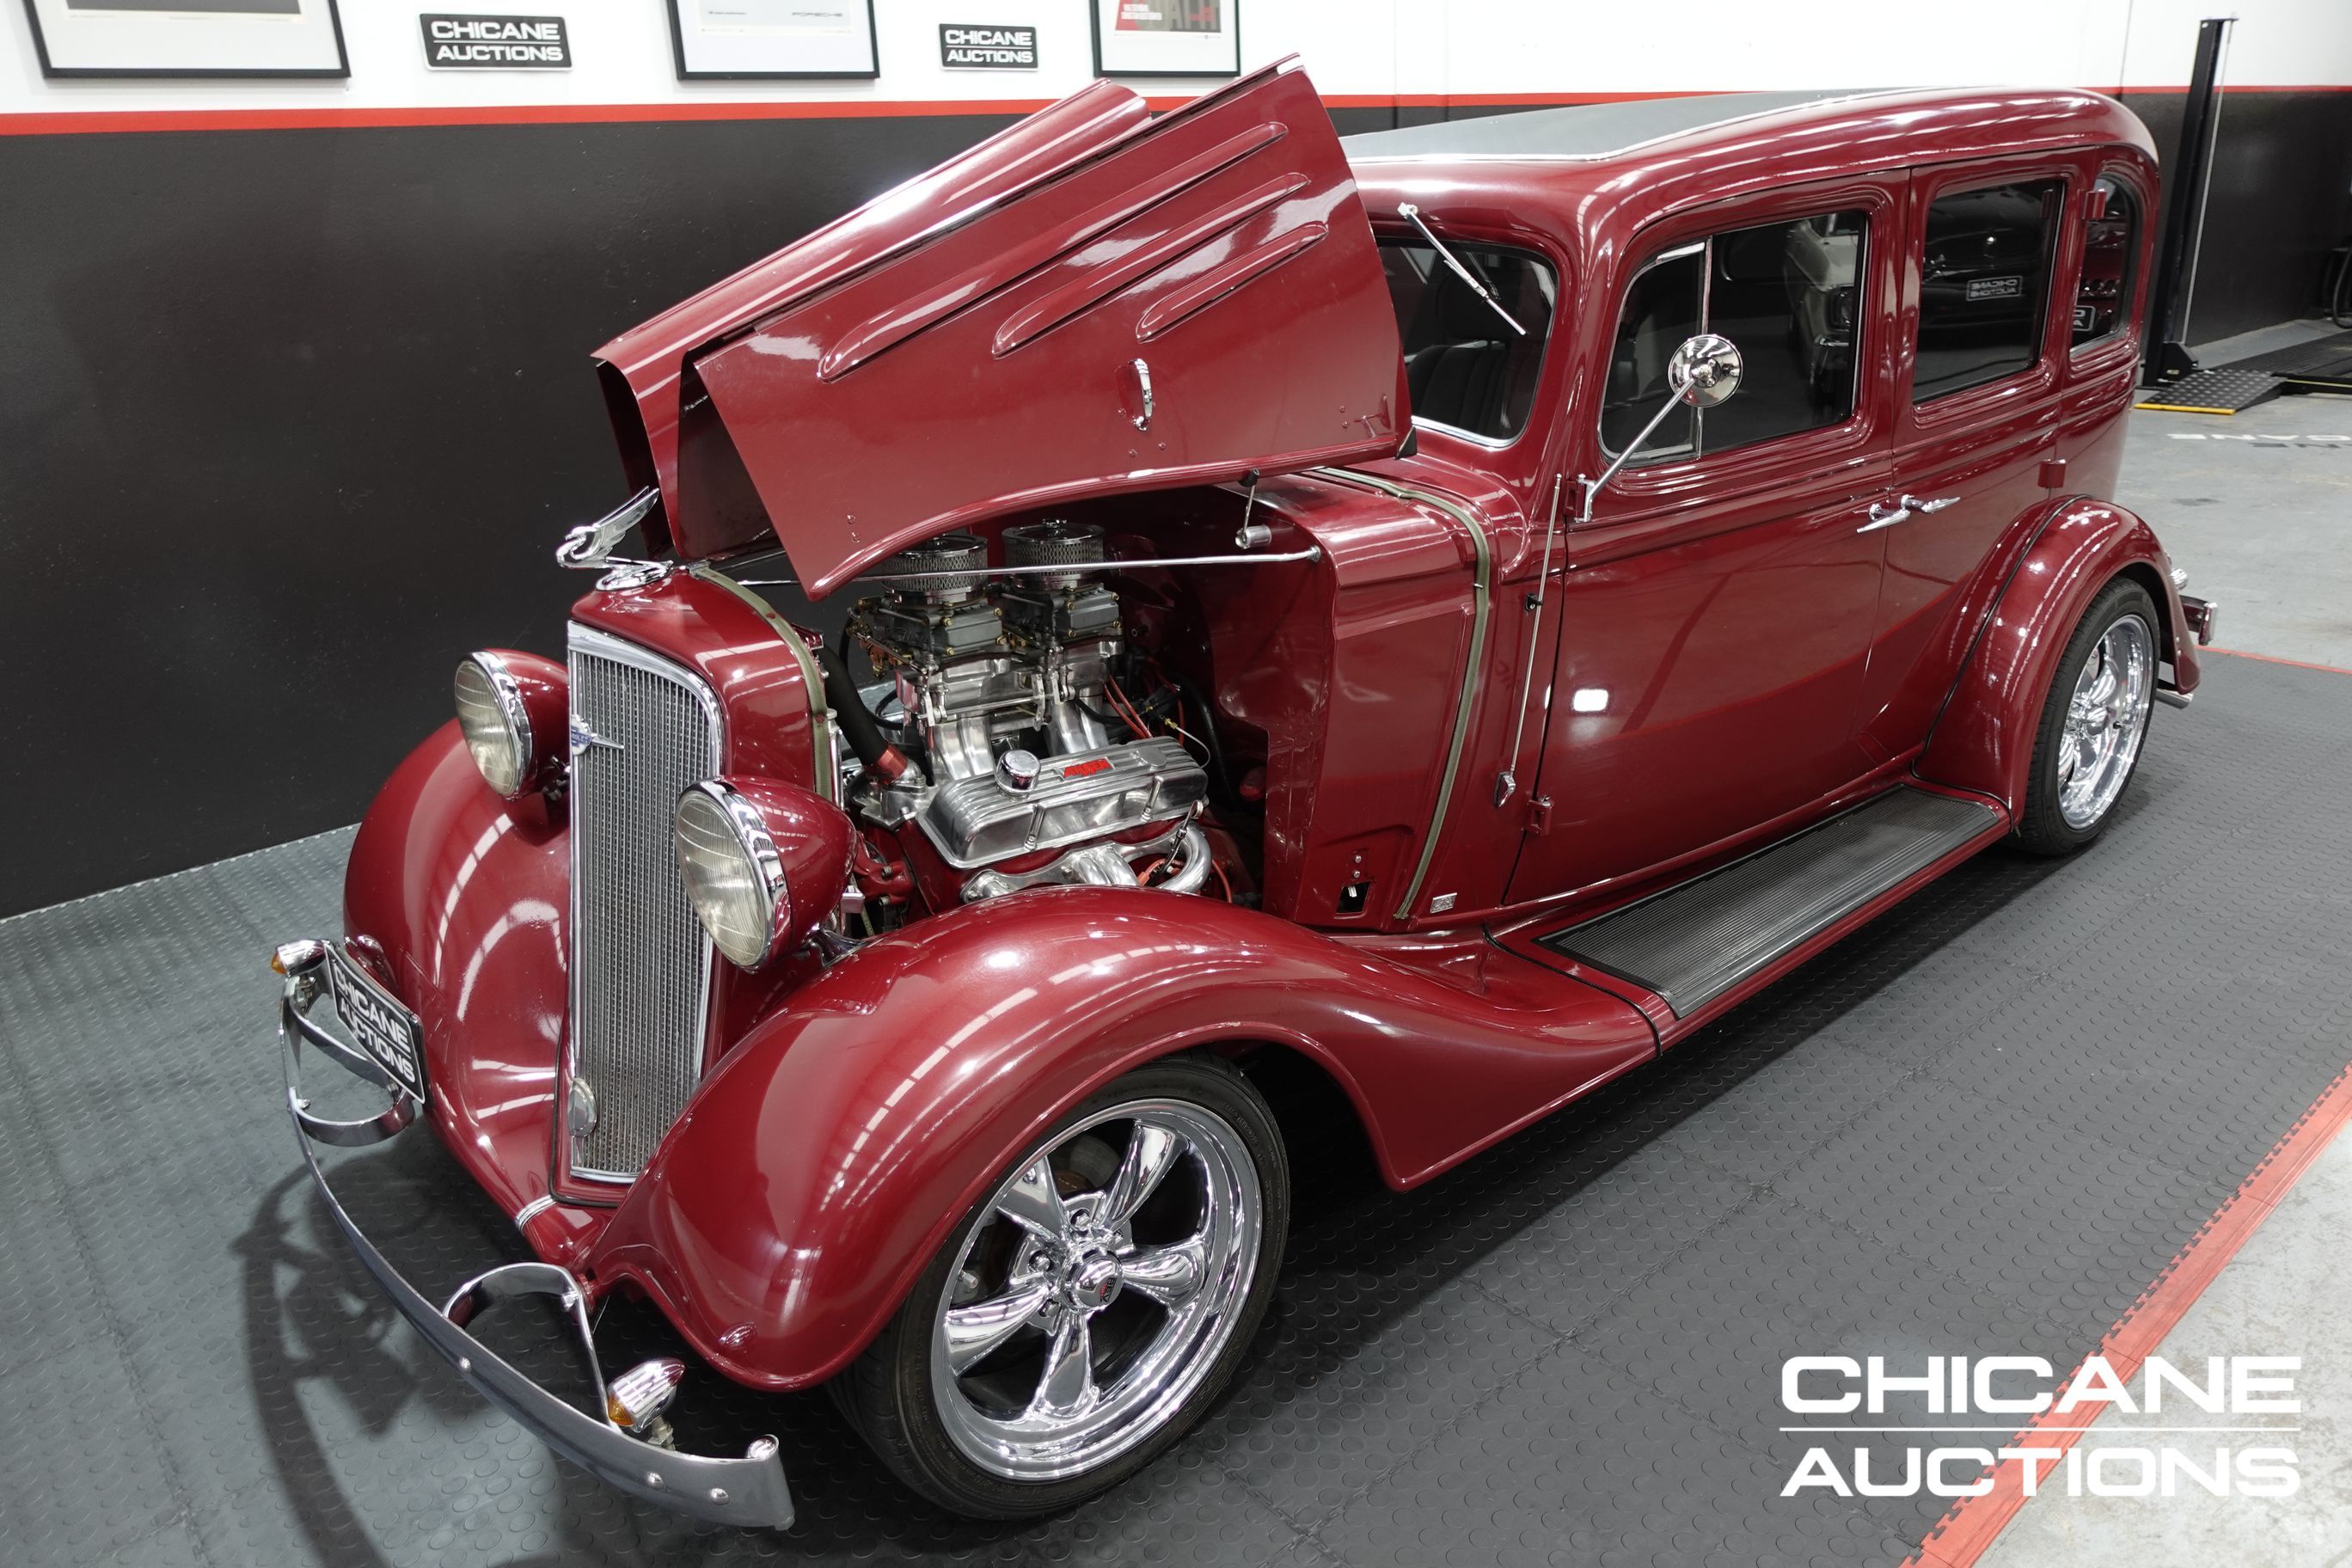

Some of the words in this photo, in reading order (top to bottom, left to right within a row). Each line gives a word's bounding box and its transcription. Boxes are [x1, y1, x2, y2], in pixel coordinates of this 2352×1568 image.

[431, 21, 560, 40] CHICANE
[945, 29, 1032, 46] CHICANE
[436, 45, 564, 61] AUCTIONS
[946, 49, 1034, 64] AUCTIONS
[334, 962, 411, 1053] CHICANE
[340, 998, 415, 1083] AUCTIONS
